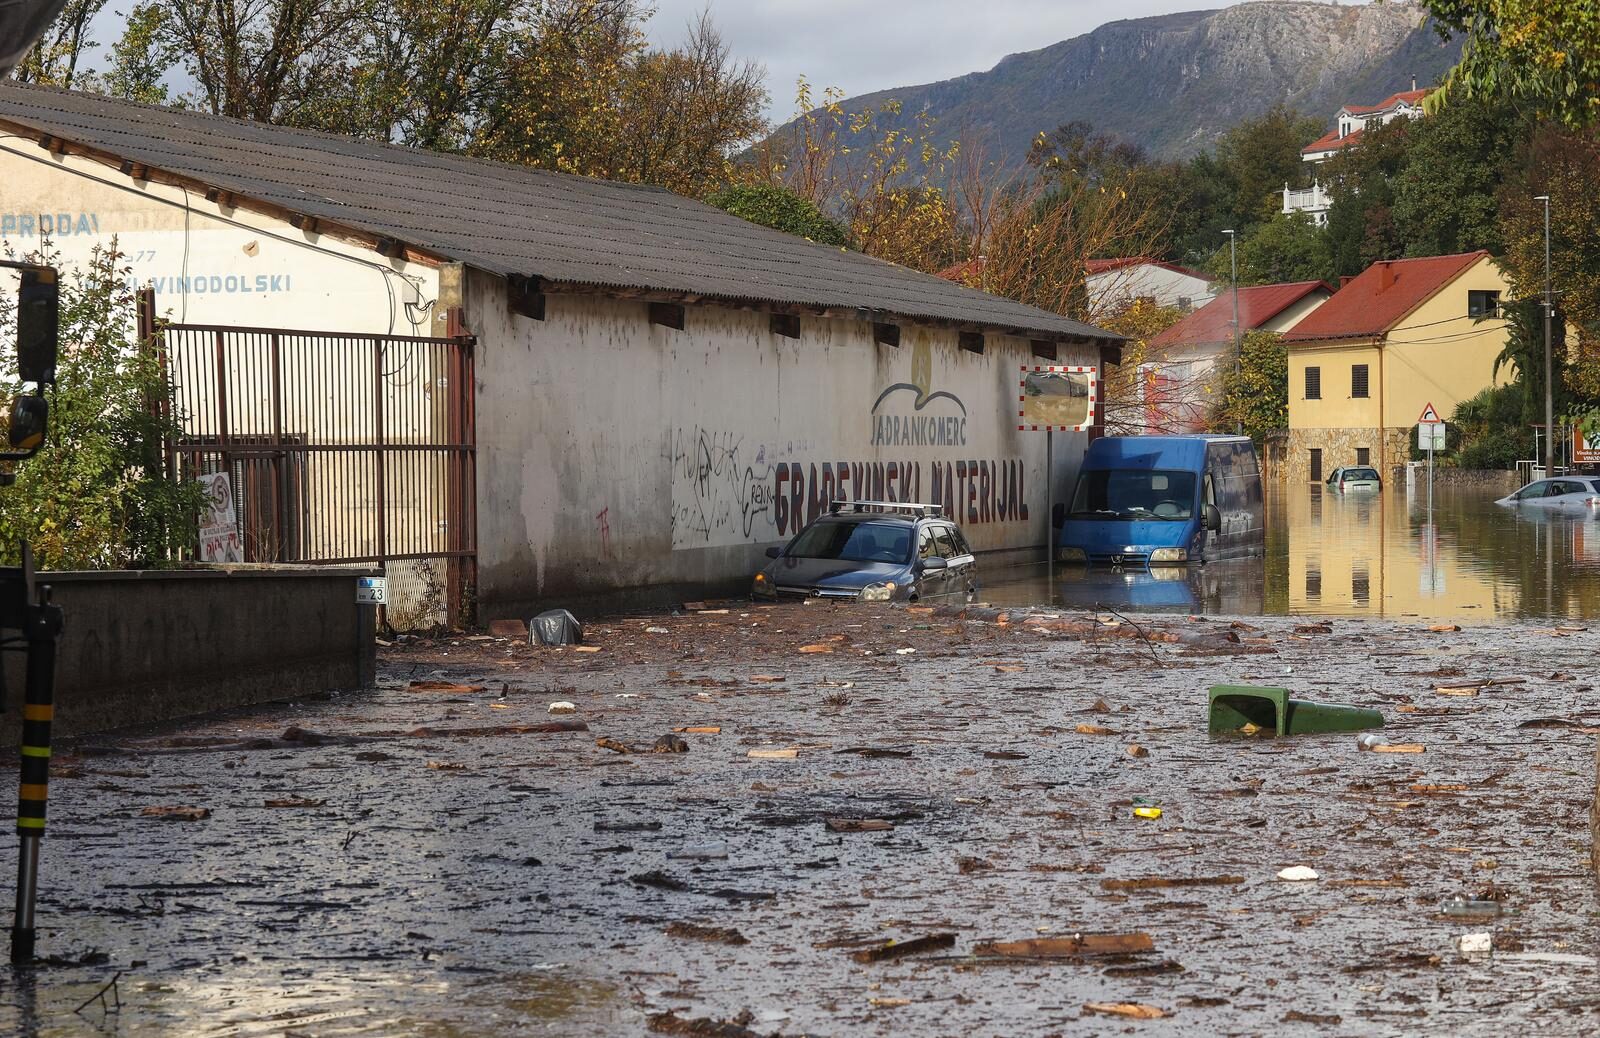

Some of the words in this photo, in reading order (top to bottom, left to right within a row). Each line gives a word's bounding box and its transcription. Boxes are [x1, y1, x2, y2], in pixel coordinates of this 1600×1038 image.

[153, 275, 290, 295] VINODOLSKI
[870, 415, 967, 446] JADRANKOMERC
[931, 459, 1029, 525] MATERIJAL
[370, 588, 383, 600] 23
